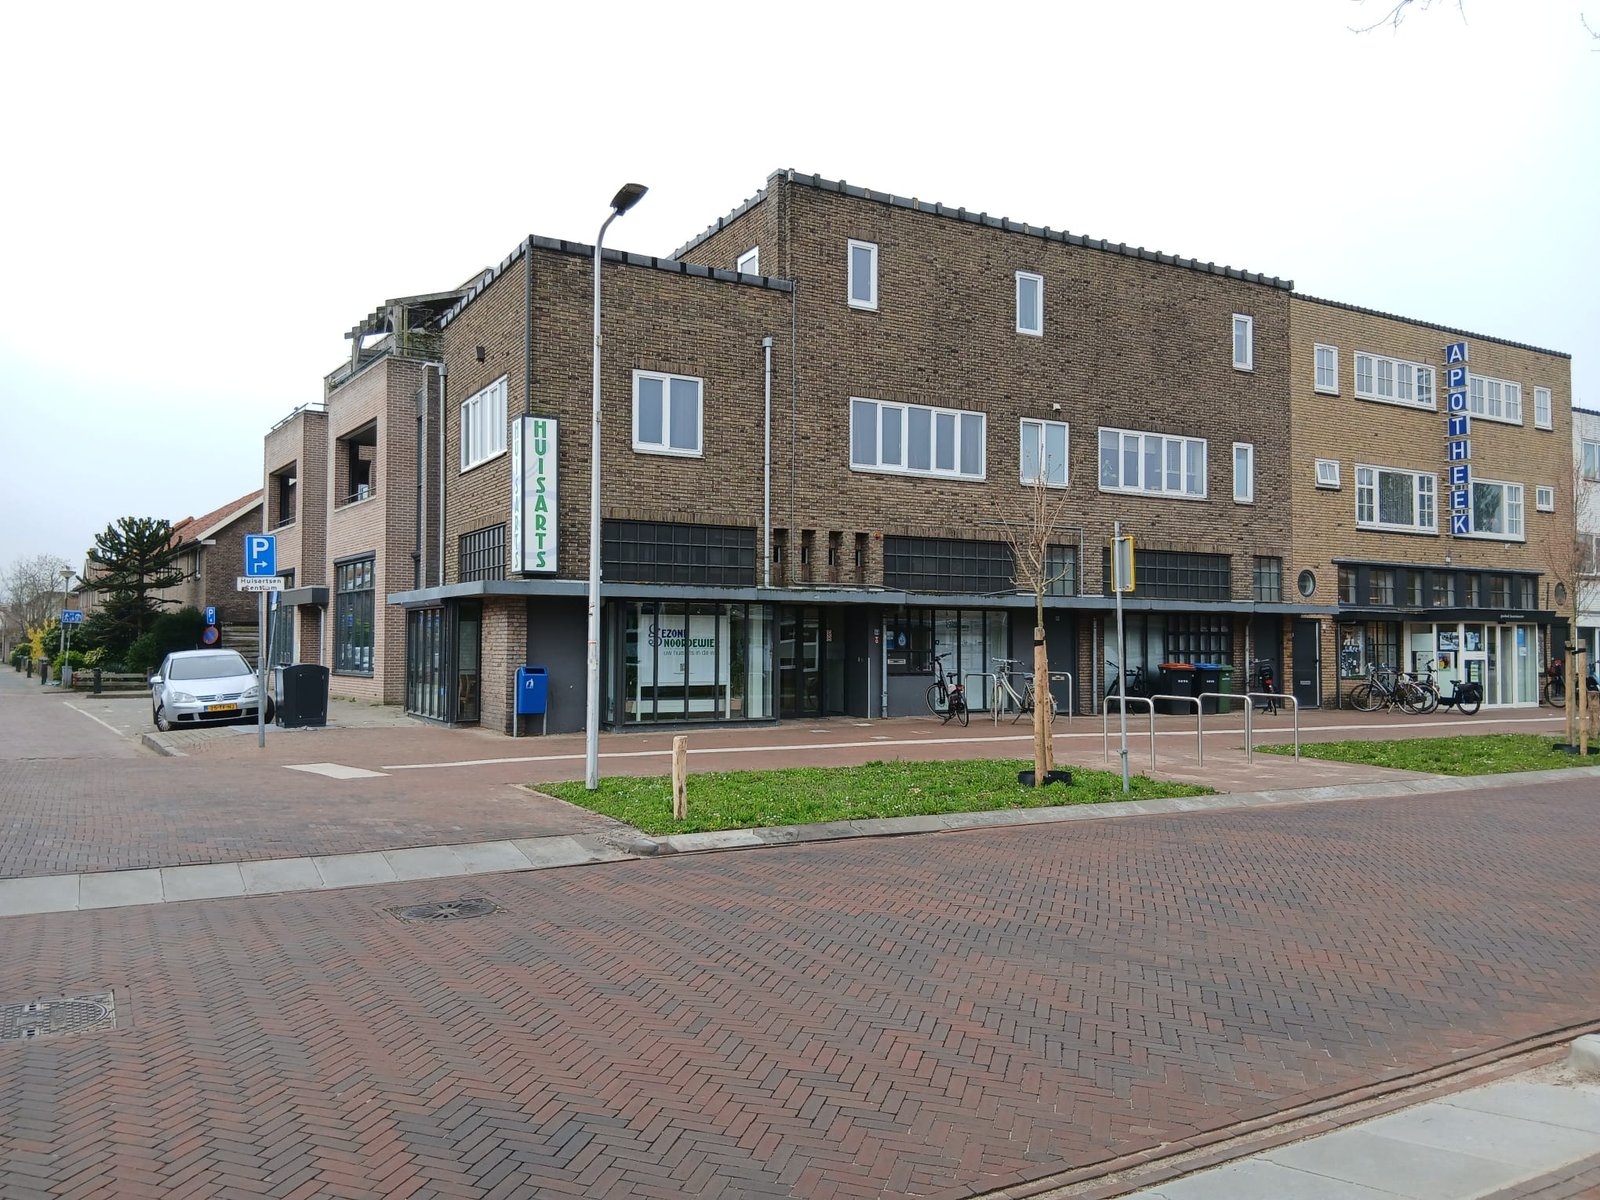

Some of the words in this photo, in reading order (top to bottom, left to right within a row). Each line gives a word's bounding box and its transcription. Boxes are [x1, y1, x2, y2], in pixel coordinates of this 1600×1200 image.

[534, 420, 548, 568] HUISARTS
[1449, 344, 1468, 534] APOTHEEK
[252, 538, 269, 559] P
